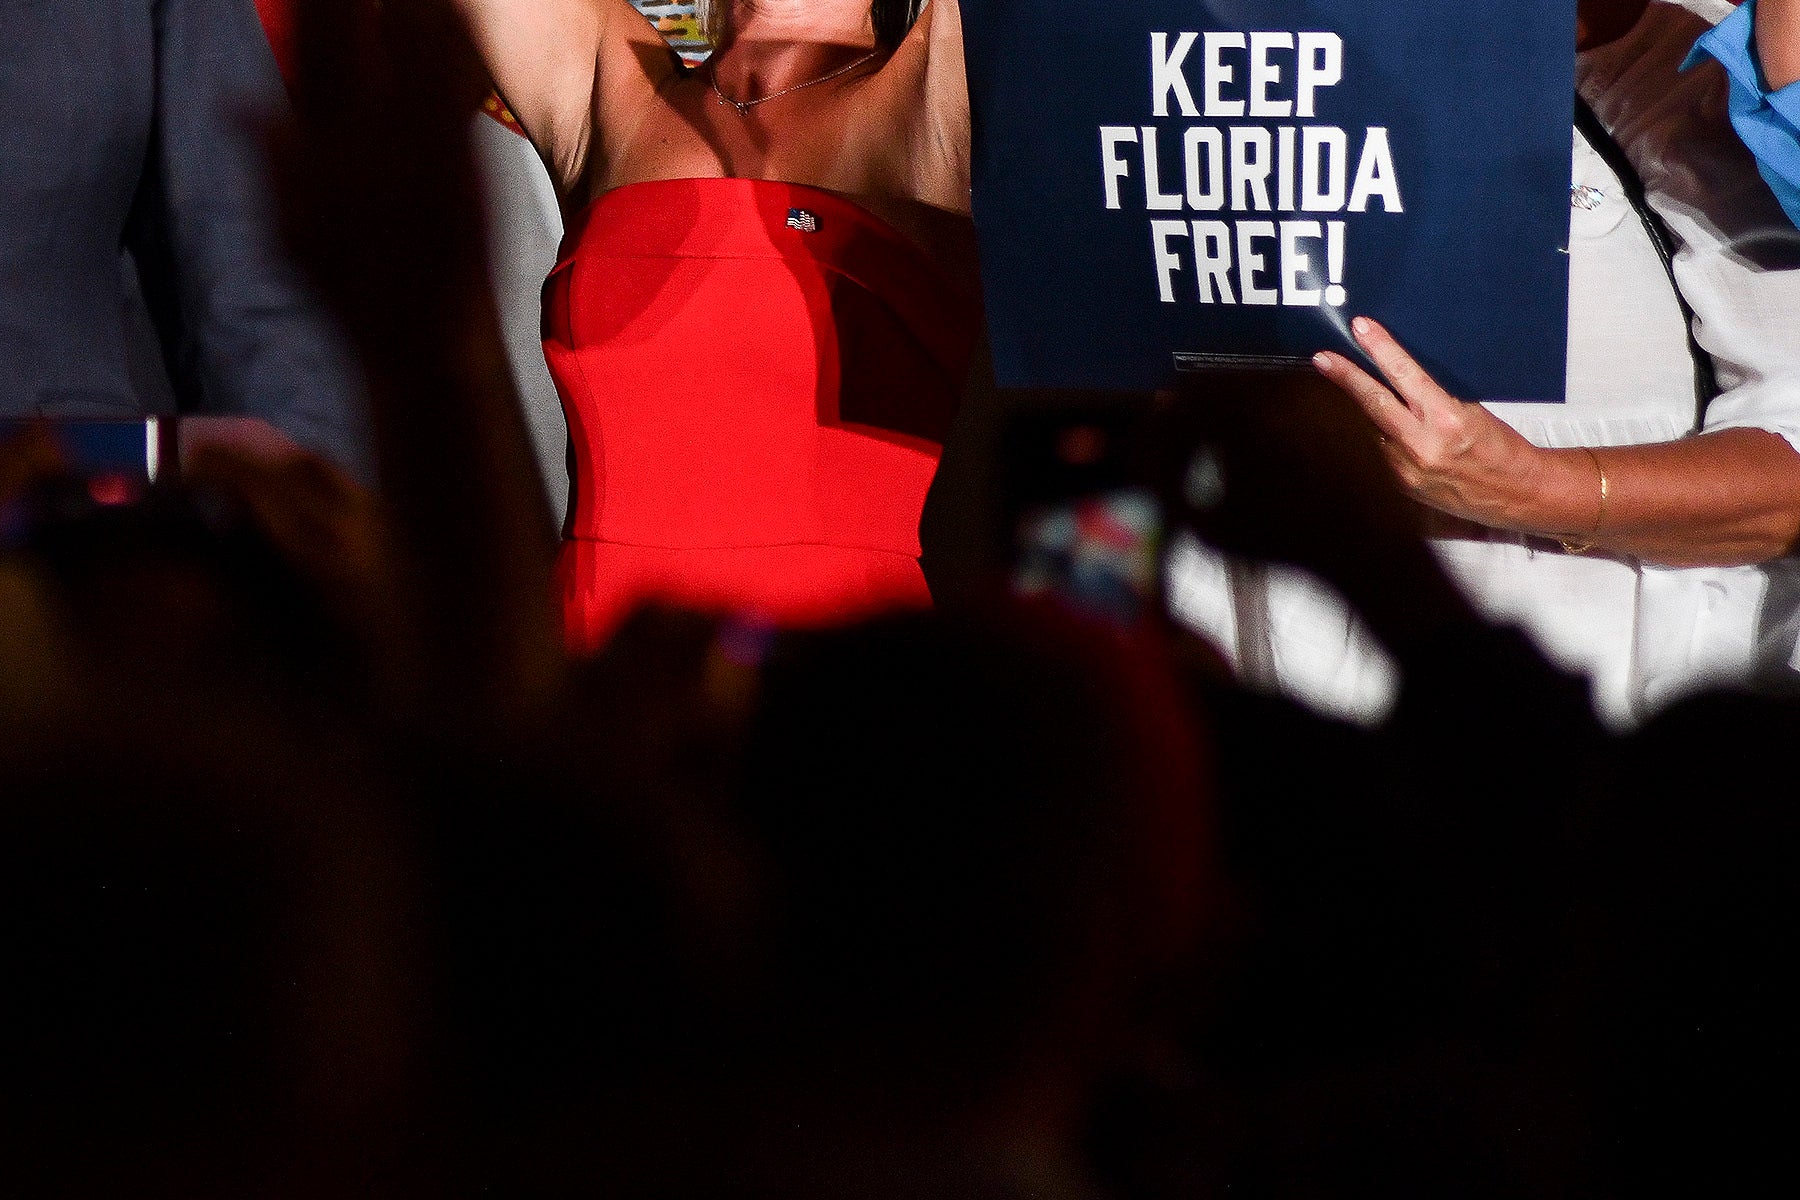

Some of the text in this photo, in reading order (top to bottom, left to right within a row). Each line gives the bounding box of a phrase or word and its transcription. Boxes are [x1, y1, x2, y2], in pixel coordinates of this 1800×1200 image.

[1150, 31, 1343, 118] KEEP
[1100, 126, 1404, 213] FLORIDA
[1150, 220, 1347, 307] FREE!
